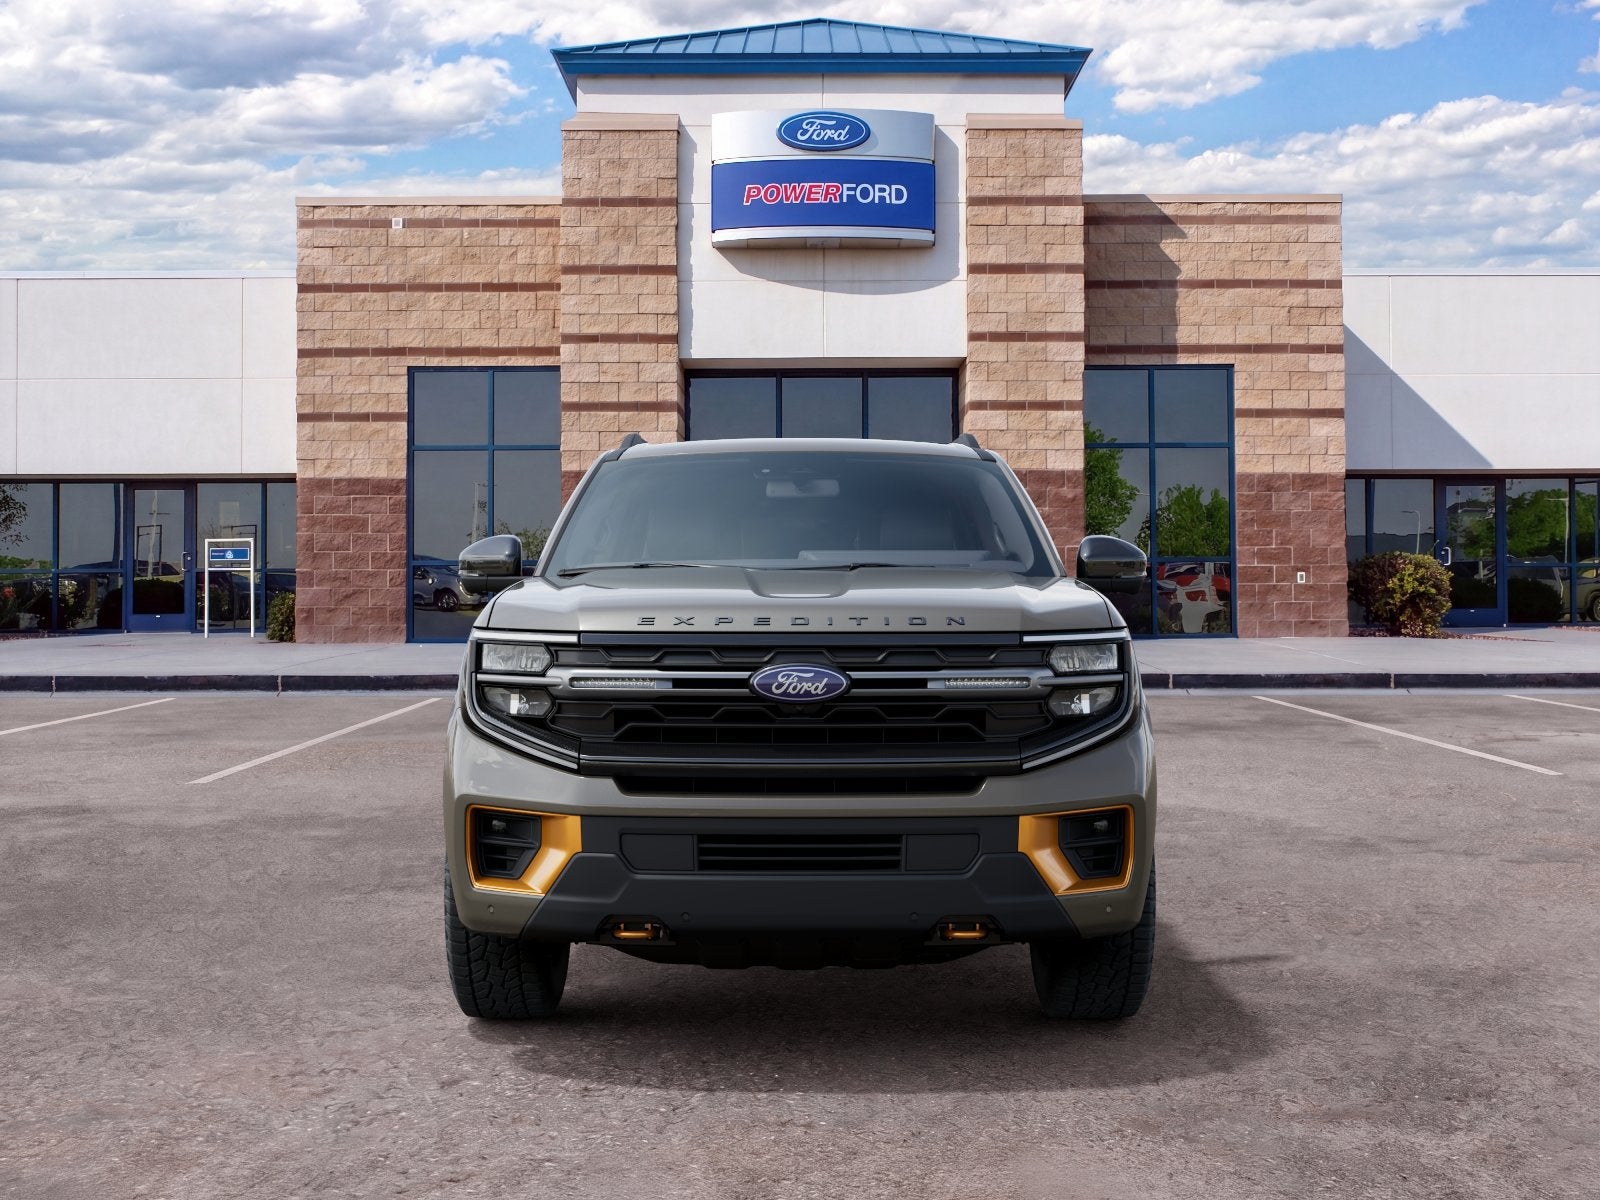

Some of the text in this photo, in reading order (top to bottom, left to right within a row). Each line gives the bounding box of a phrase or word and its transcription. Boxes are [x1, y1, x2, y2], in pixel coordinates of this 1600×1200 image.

[797, 119, 850, 141] Ford
[637, 616, 965, 626] EXPEDITION
[772, 671, 827, 695] Ford
